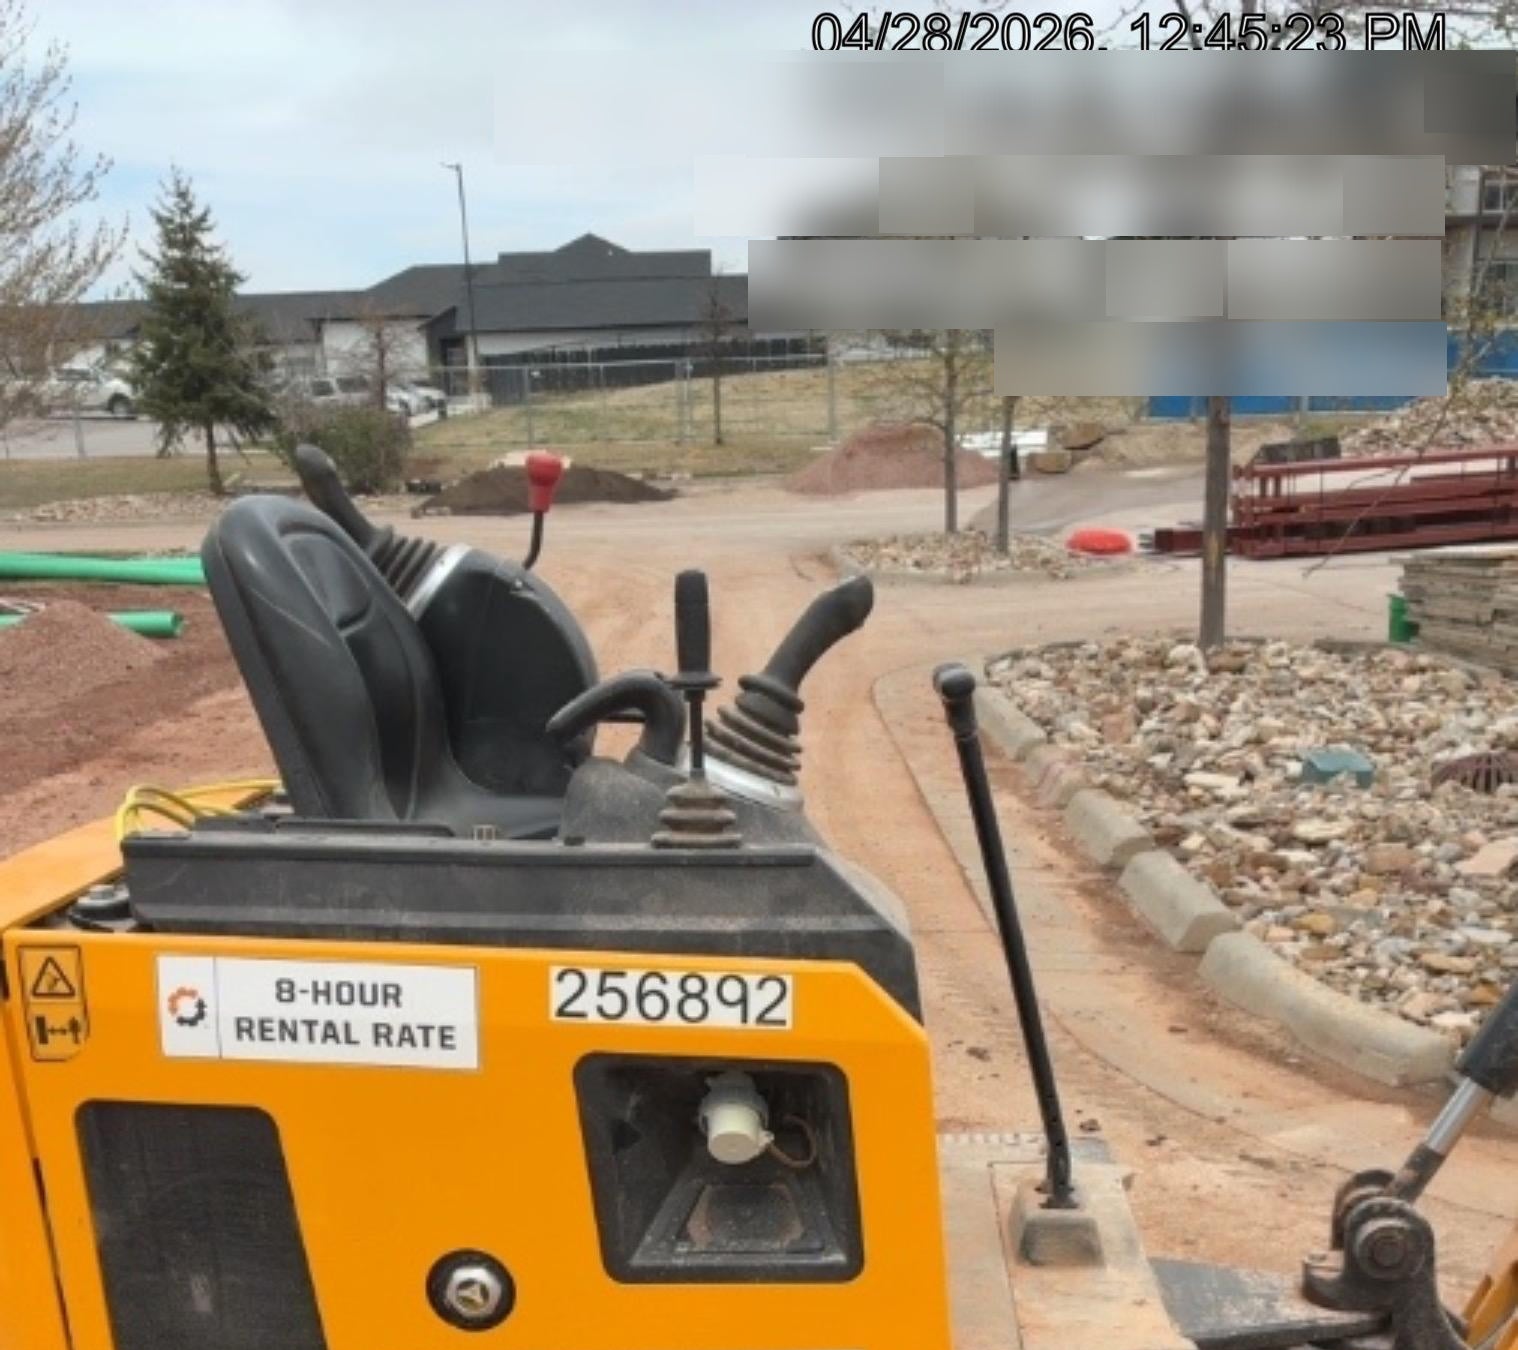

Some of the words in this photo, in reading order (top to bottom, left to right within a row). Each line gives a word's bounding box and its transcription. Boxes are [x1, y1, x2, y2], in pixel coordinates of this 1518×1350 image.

[275, 978, 403, 1008] 8-HOUR
[554, 967, 788, 1026] 256892
[235, 1016, 360, 1046] RENTAL
[372, 1022, 457, 1051] RATE
